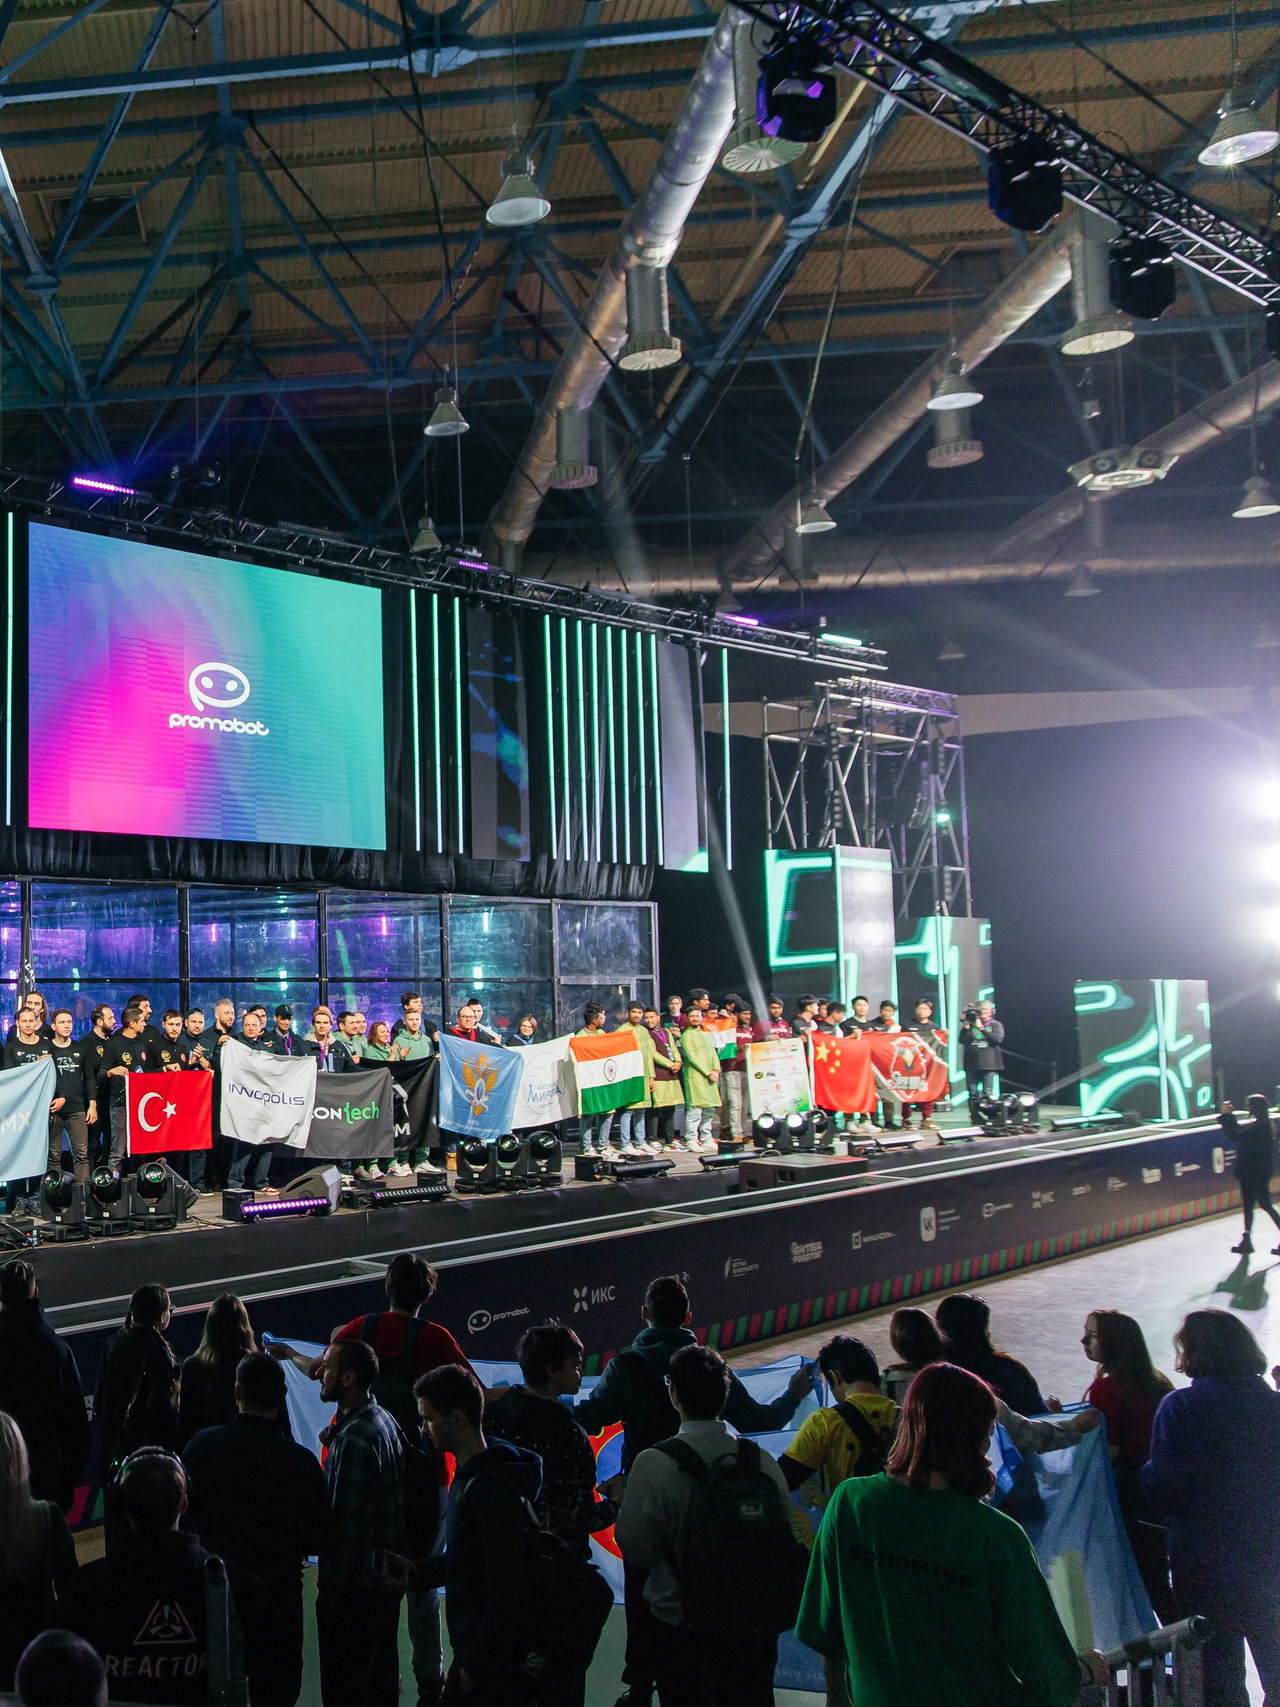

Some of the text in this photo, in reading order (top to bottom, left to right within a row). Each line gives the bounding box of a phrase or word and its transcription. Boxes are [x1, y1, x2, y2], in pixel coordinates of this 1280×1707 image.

[168, 711, 270, 737] promobot
[312, 1101, 380, 1125] ONtech
[591, 1285, 616, 1305] ИКС
[492, 1307, 530, 1322] promobot
